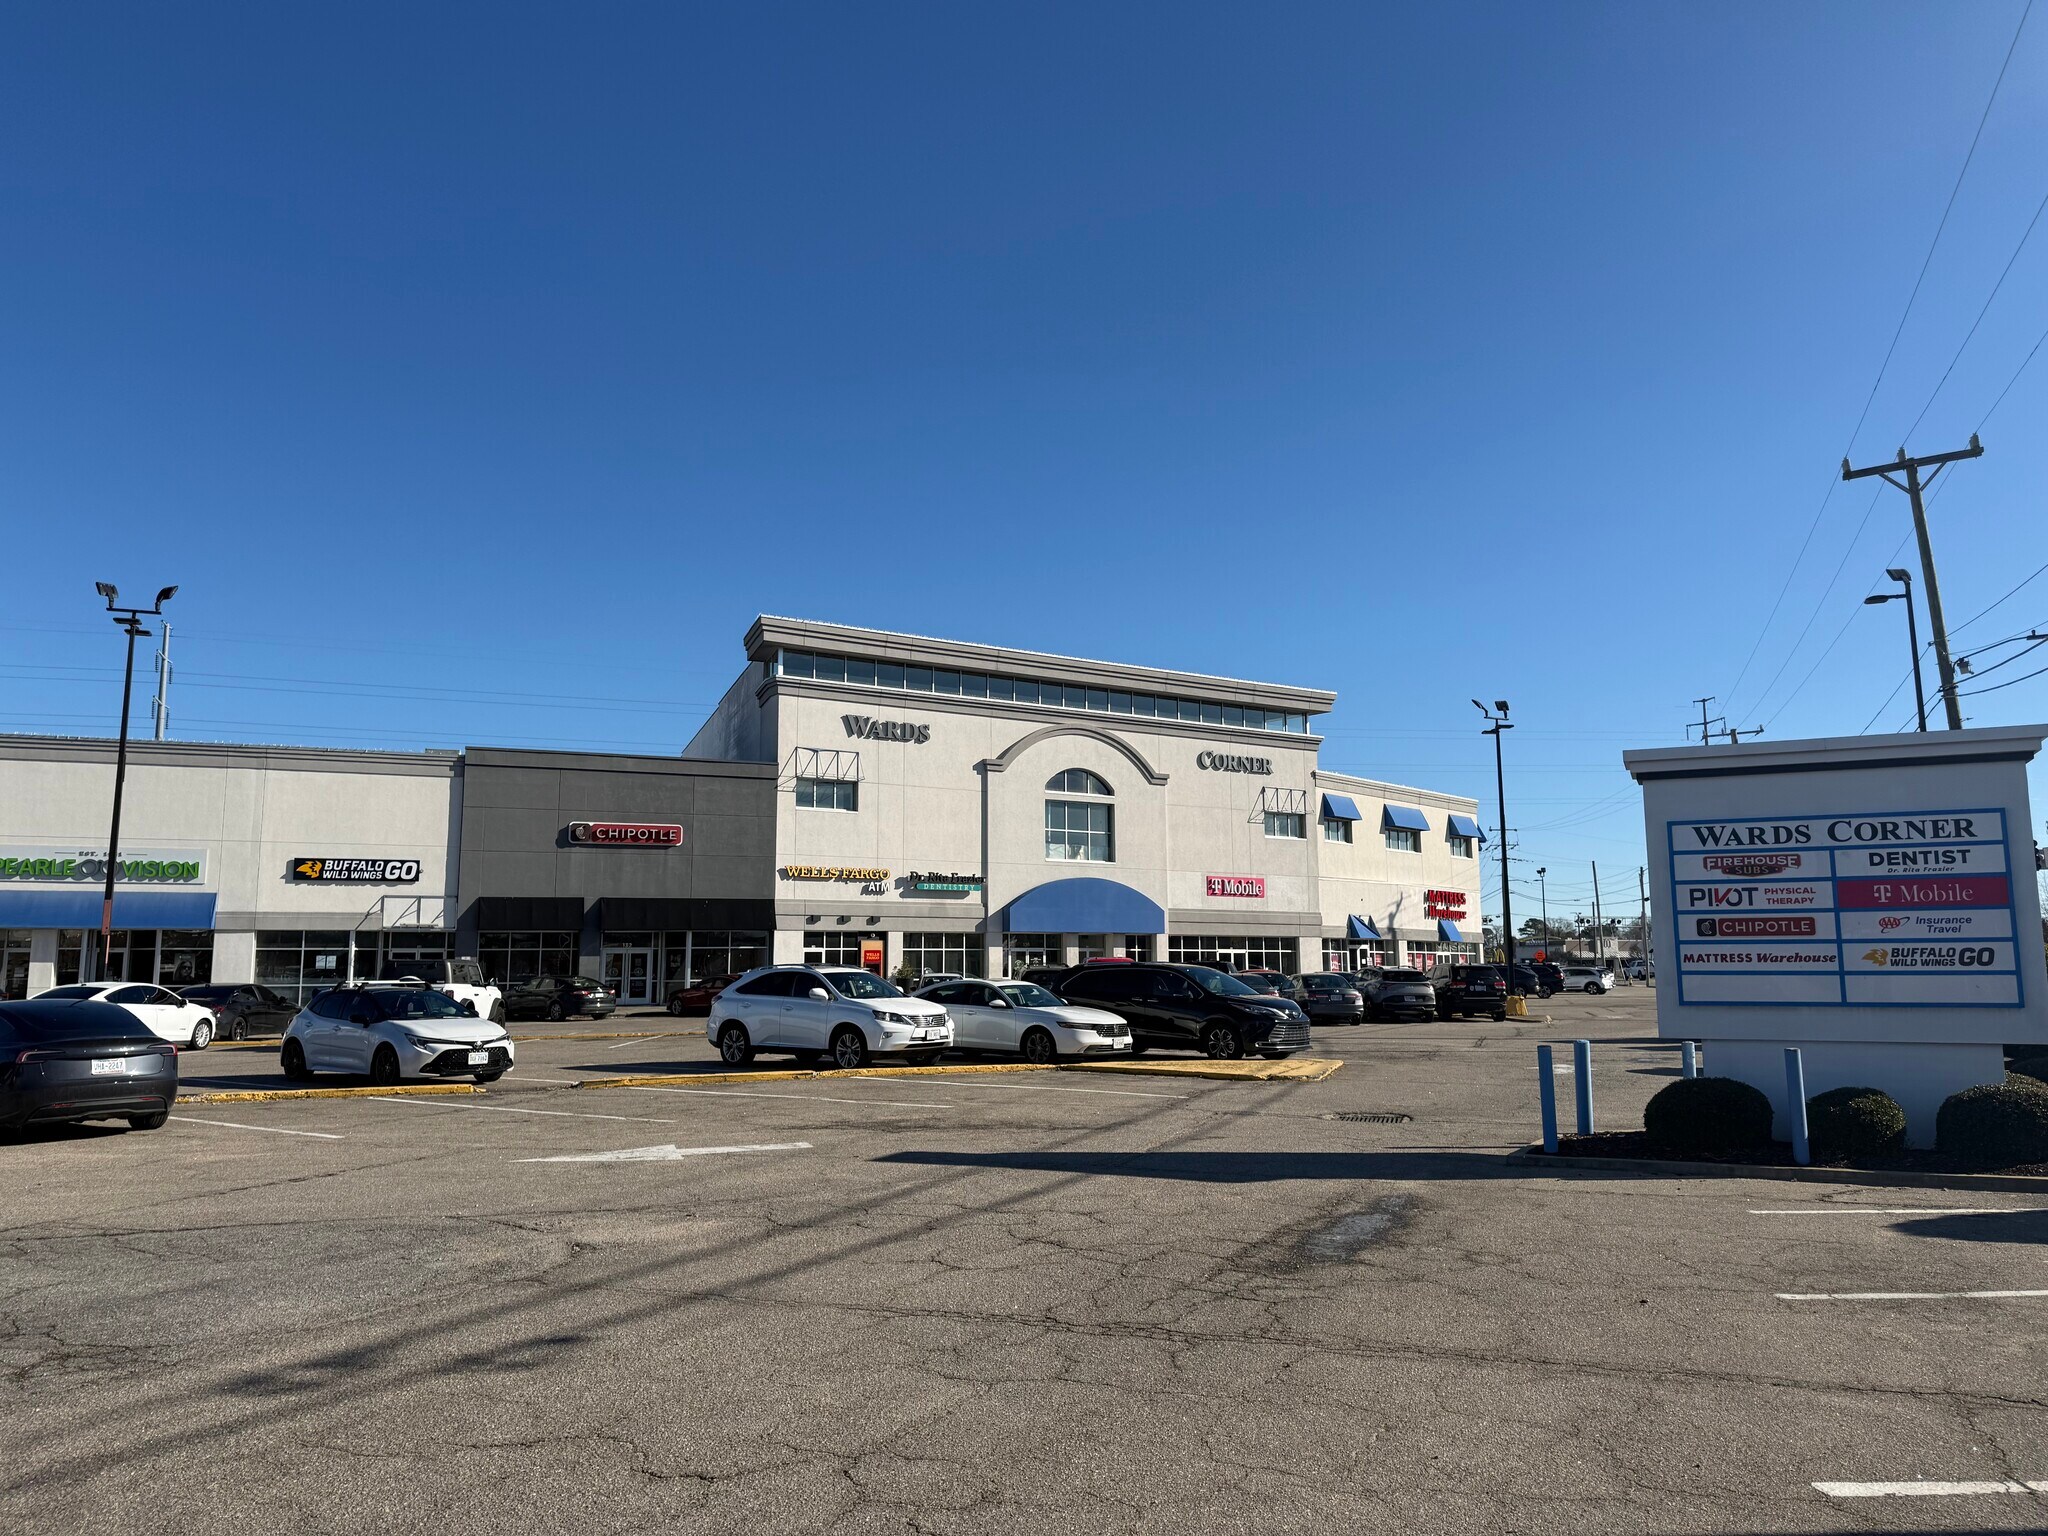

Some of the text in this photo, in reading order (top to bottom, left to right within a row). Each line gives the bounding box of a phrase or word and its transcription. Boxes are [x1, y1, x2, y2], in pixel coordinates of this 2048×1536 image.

[843, 714, 931, 742] WARDS
[1199, 750, 1274, 774] CORNER
[596, 828, 678, 840] CHIPOTLE
[1691, 818, 1978, 847] WARDS CORNER
[1706, 855, 1799, 871] FIREHOUSE
[1869, 849, 1971, 867] DENTIST
[122, 859, 200, 878] VISION
[324, 860, 385, 871] BUFFALO
[384, 861, 418, 880] GO
[1735, 866, 1769, 875] SUBS
[322, 871, 382, 879] WILD WINGS
[785, 865, 890, 880] WELLS FARGO
[868, 882, 890, 892] ATM
[923, 883, 975, 891] DENTISTRY
[1211, 878, 1263, 895] T Mobile
[1764, 887, 1816, 895] PHYSICAL
[1427, 890, 1466, 905] MATTRESS
[1689, 887, 1759, 907] PIVOT
[1873, 884, 1974, 903] T Mobile
[1766, 897, 1815, 905] THERAPY
[1880, 917, 1900, 928] AAA
[1915, 916, 1972, 925] Insurance
[1722, 921, 1811, 933] CHIPOTLE
[1926, 925, 1962, 933] Travel
[1683, 952, 1837, 963] MATTRESS Warehouse
[1891, 947, 1956, 958] BUFFALO
[1958, 947, 1995, 967] GO
[1890, 958, 1956, 967] WILD WINGS
